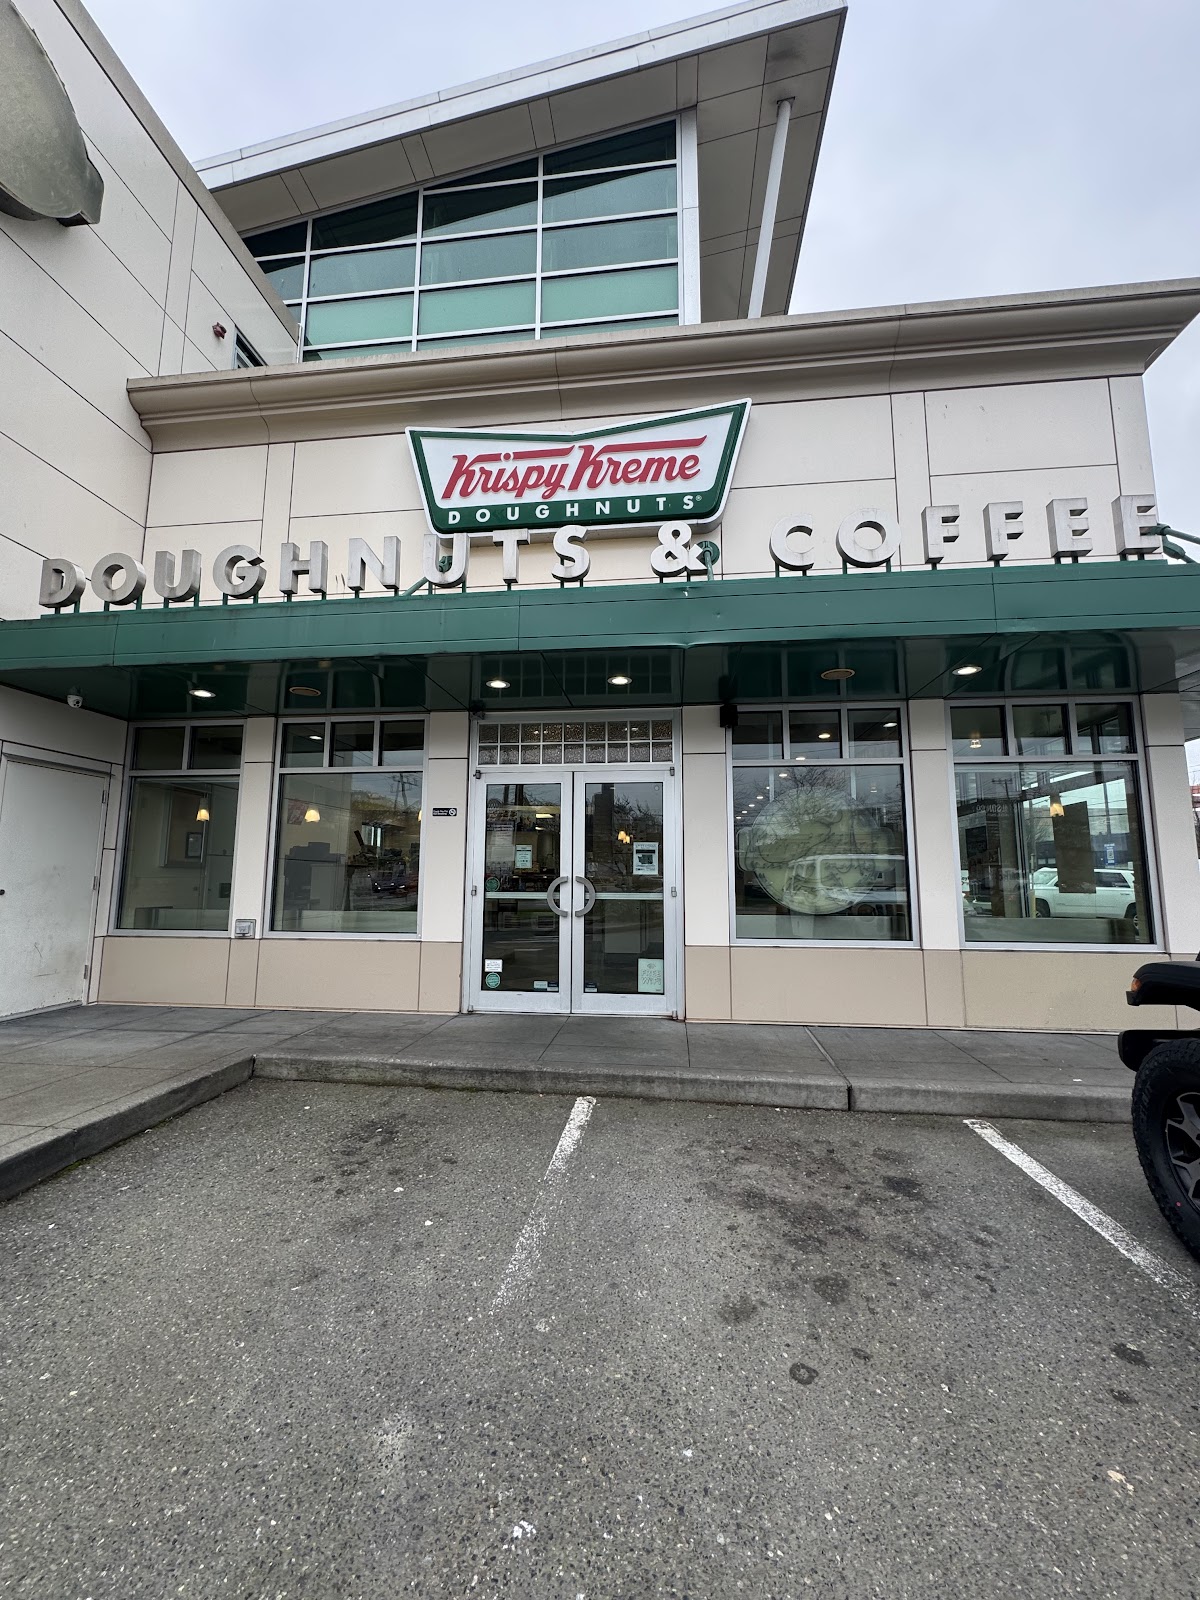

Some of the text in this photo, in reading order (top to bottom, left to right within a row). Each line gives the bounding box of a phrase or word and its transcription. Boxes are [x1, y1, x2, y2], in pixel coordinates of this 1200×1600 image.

[441, 435, 707, 500] Krispy Kreme
[39, 494, 1162, 608] DOUGHNUTS & COFFEE
